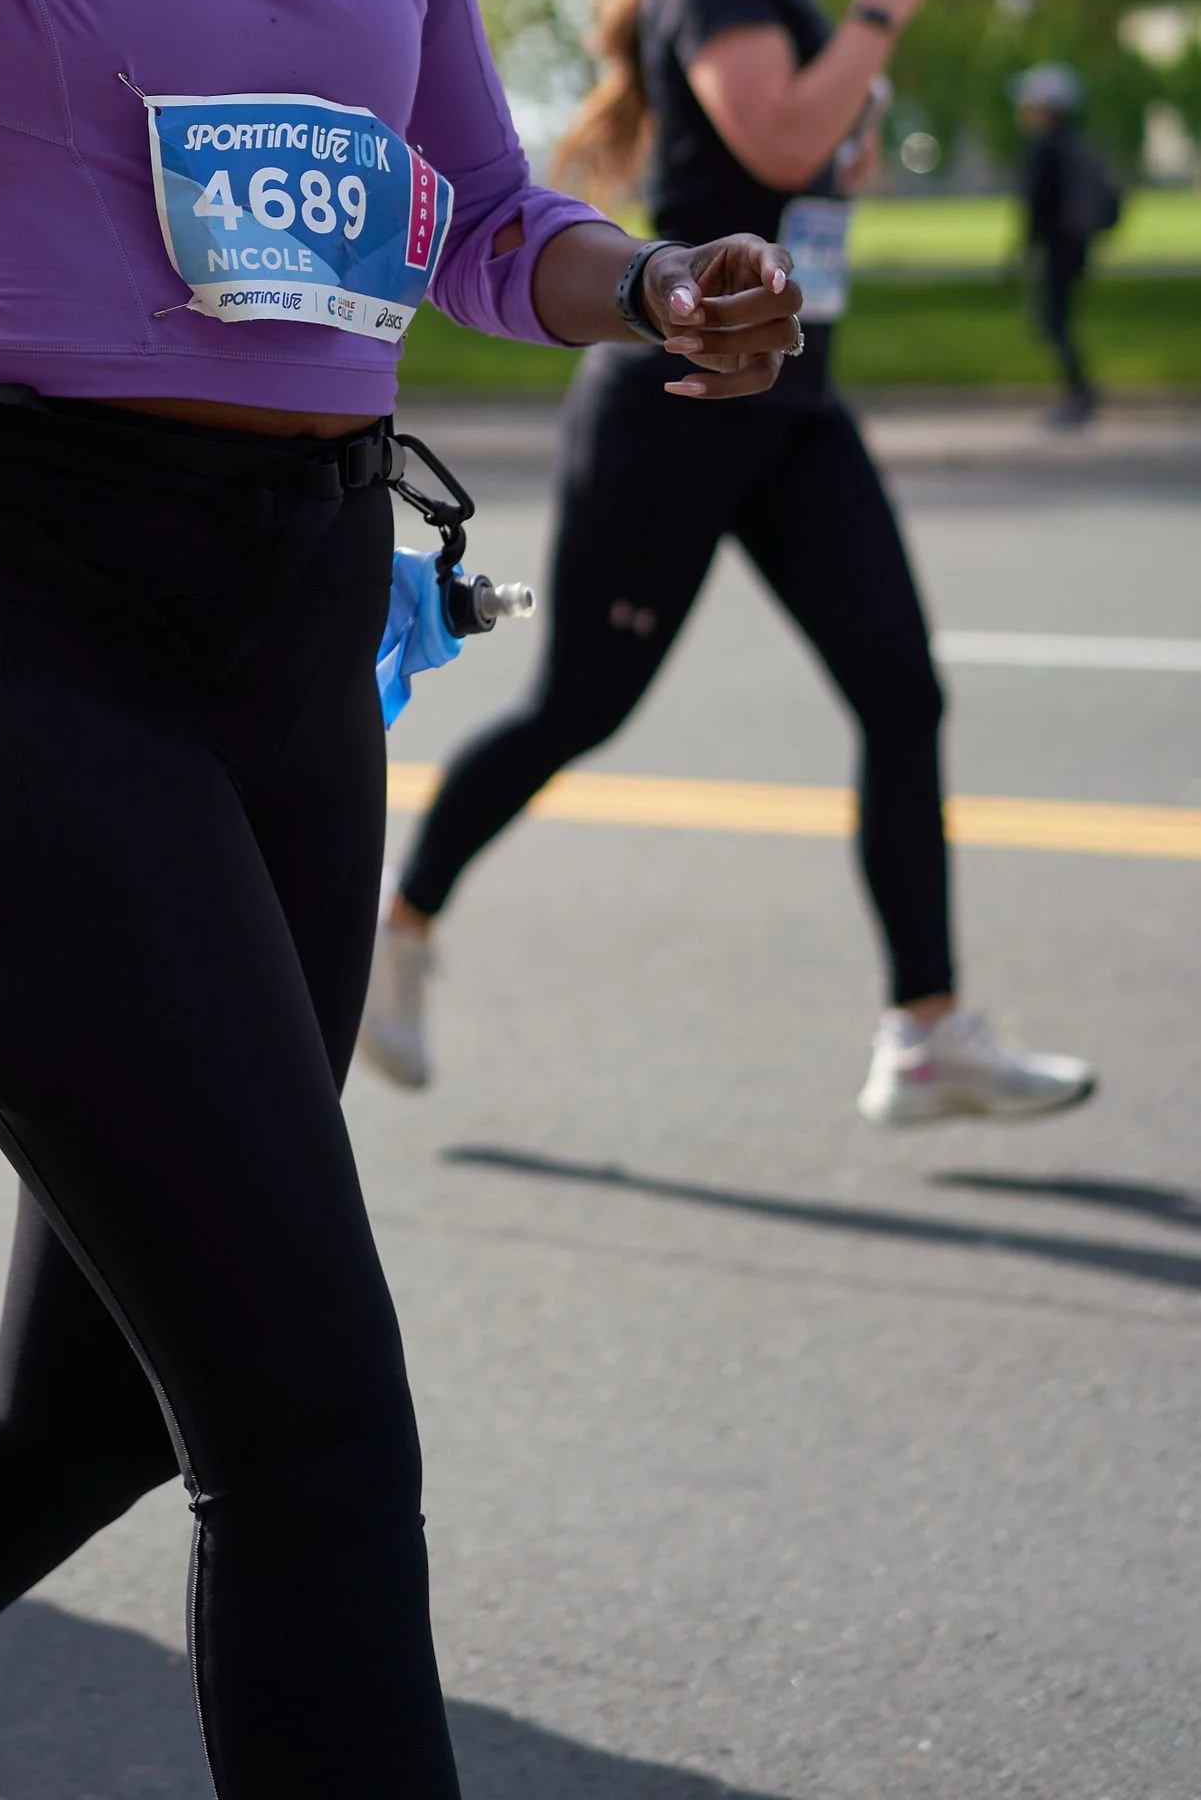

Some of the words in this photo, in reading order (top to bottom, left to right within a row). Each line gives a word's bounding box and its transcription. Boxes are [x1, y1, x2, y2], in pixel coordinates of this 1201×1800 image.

[354, 131, 391, 173] 10K
[192, 167, 367, 240] 4689
[207, 247, 313, 272] NICOLE
